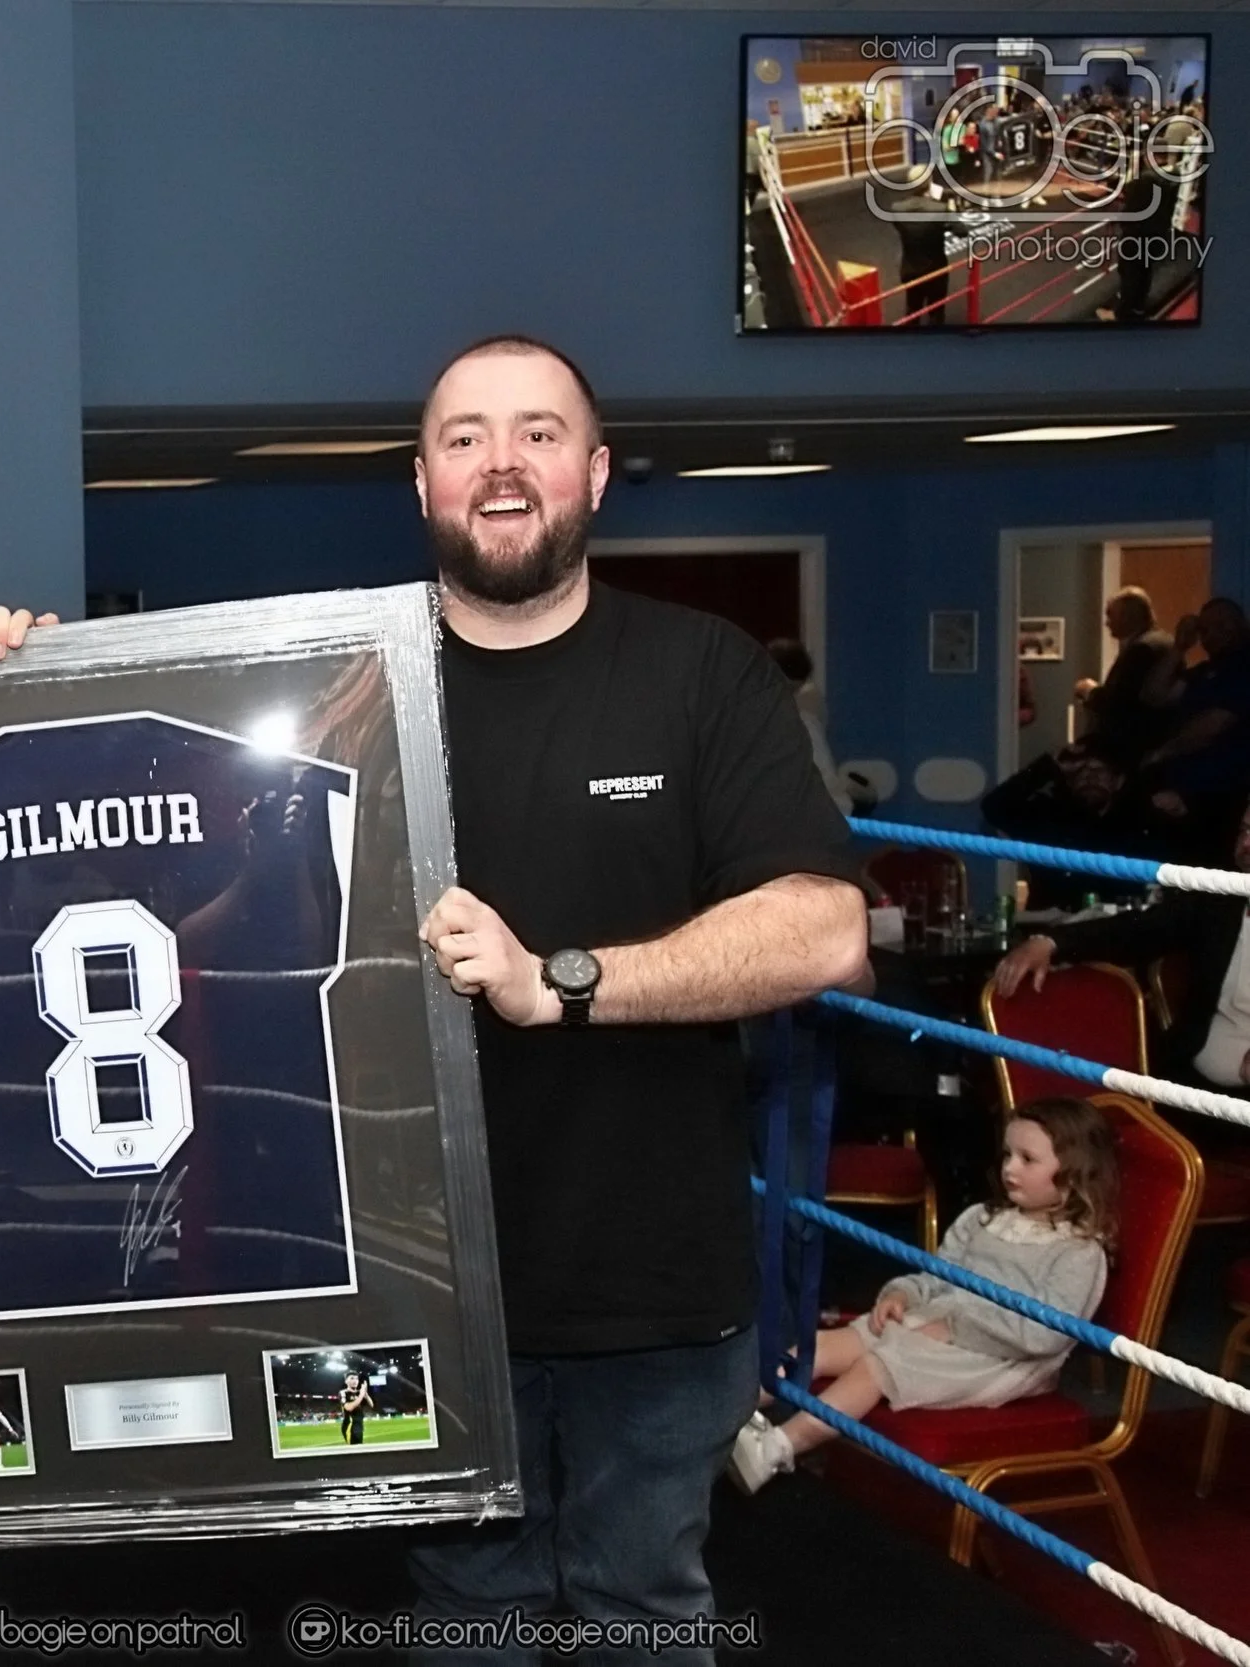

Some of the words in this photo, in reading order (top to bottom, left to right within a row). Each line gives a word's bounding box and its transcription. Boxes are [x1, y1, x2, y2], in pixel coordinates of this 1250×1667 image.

[589, 774, 665, 795] REPRESENT
[31, 898, 195, 1179] 8
[122, 1413, 141, 1424] Billy
[143, 1412, 179, 1422] Gilmour
